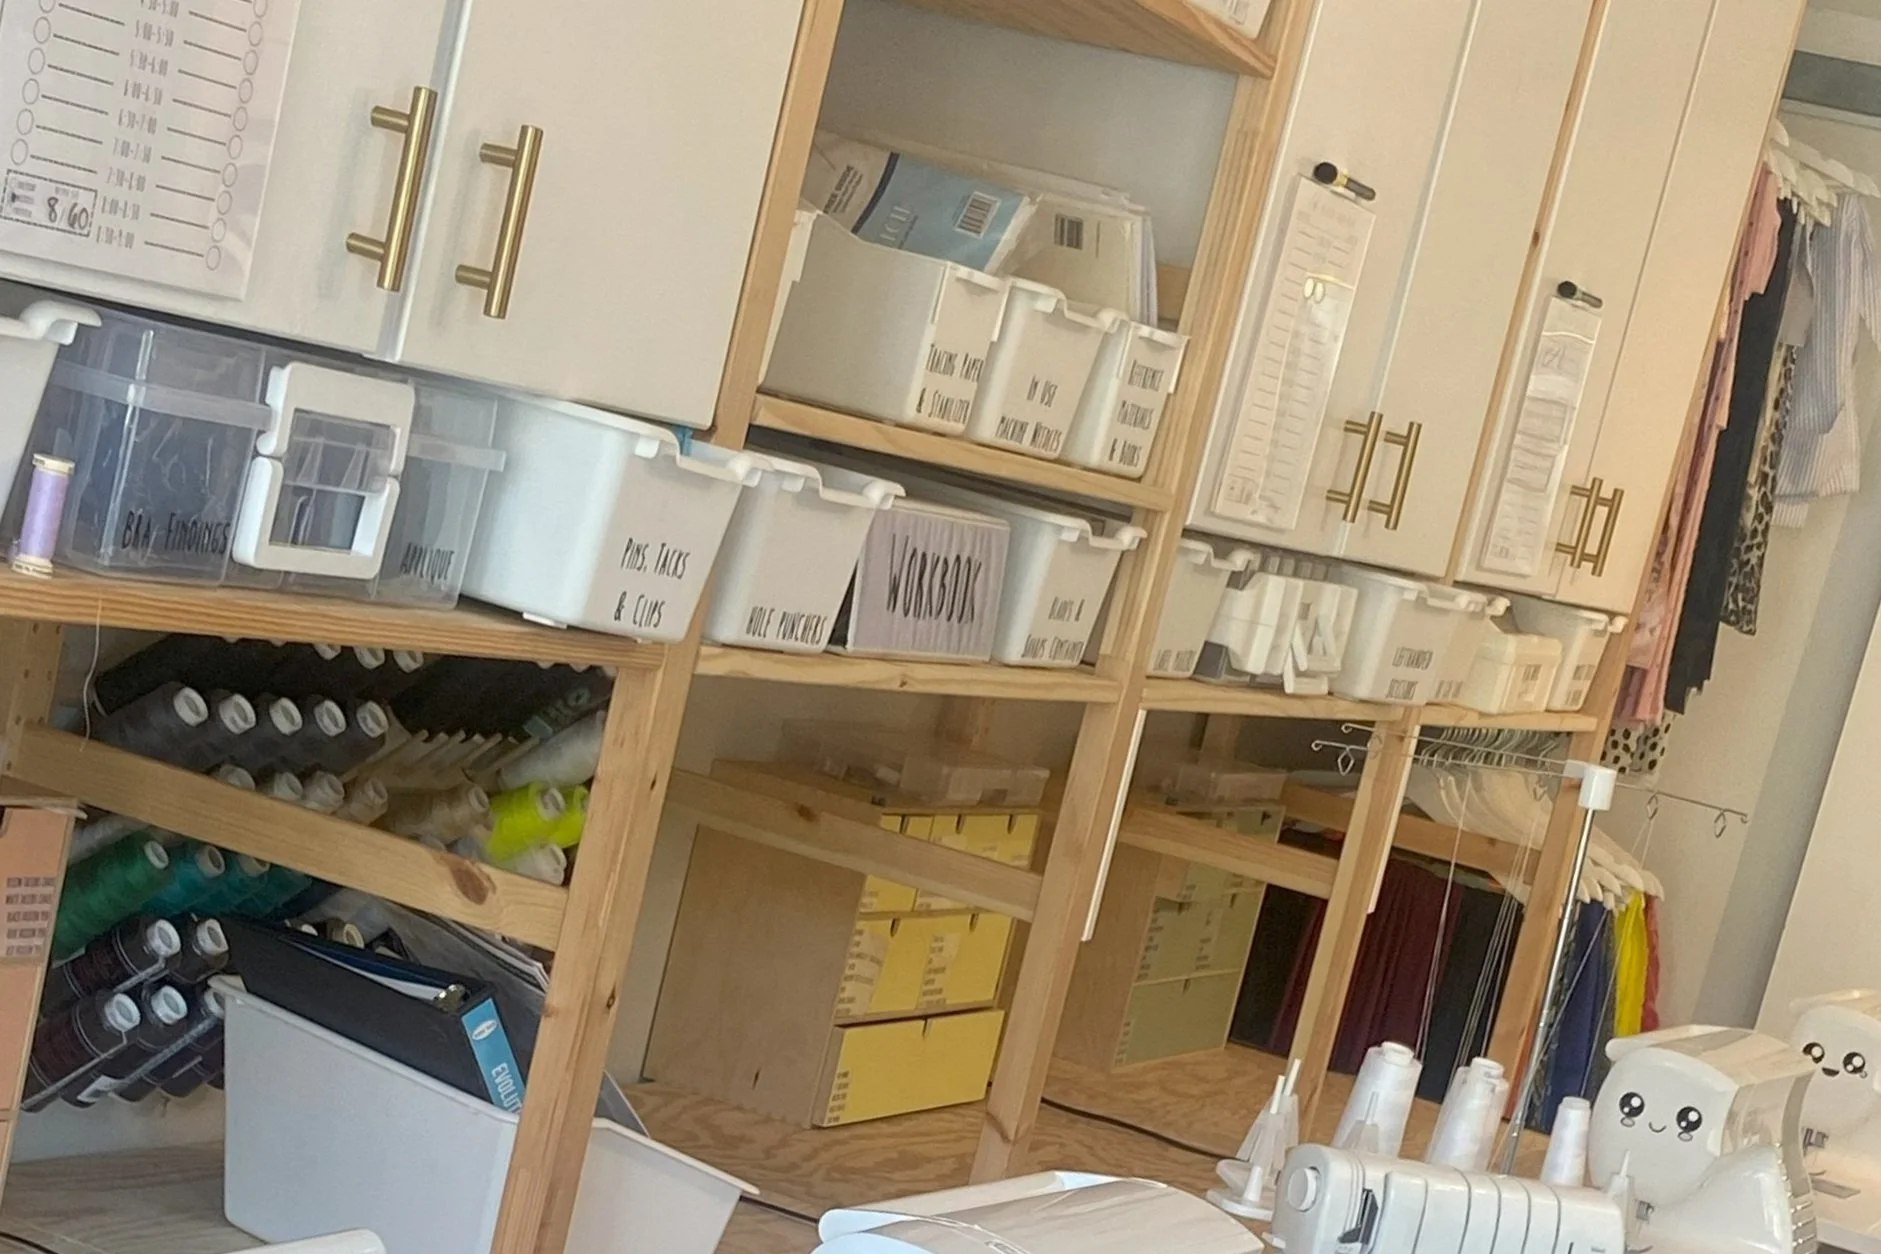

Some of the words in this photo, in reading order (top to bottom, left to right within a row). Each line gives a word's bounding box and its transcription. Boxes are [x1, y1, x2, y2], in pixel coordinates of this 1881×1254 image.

[653, 542, 691, 580] TACKS
[886, 532, 983, 625] WORKBOOK
[632, 594, 666, 628] CLIPS
